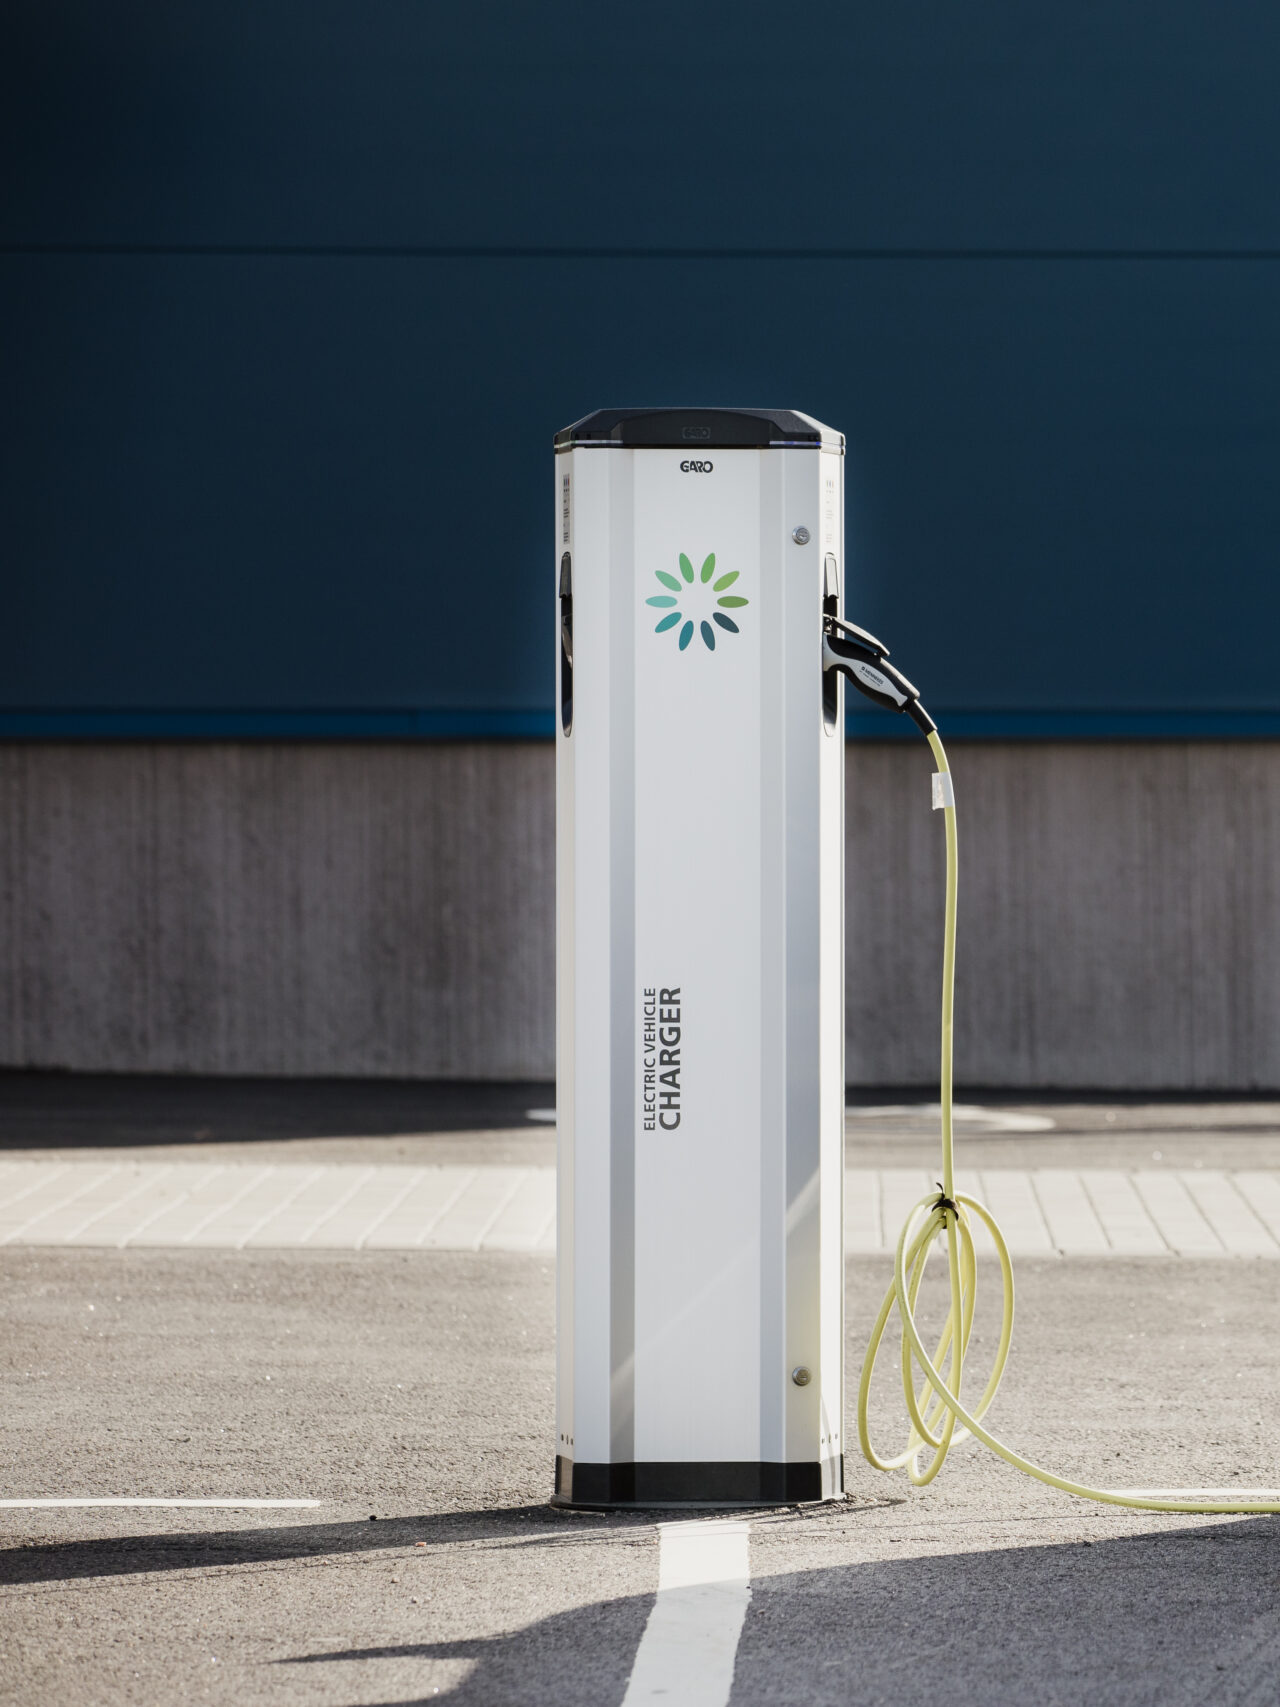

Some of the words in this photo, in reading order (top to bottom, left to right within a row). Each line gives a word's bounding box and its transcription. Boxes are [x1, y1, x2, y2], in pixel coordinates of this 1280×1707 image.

[680, 460, 713, 473] GARO
[643, 988, 656, 1054] VEHICLE
[659, 987, 681, 1131] CHARGER
[643, 1058, 656, 1131] ELECTRIC
